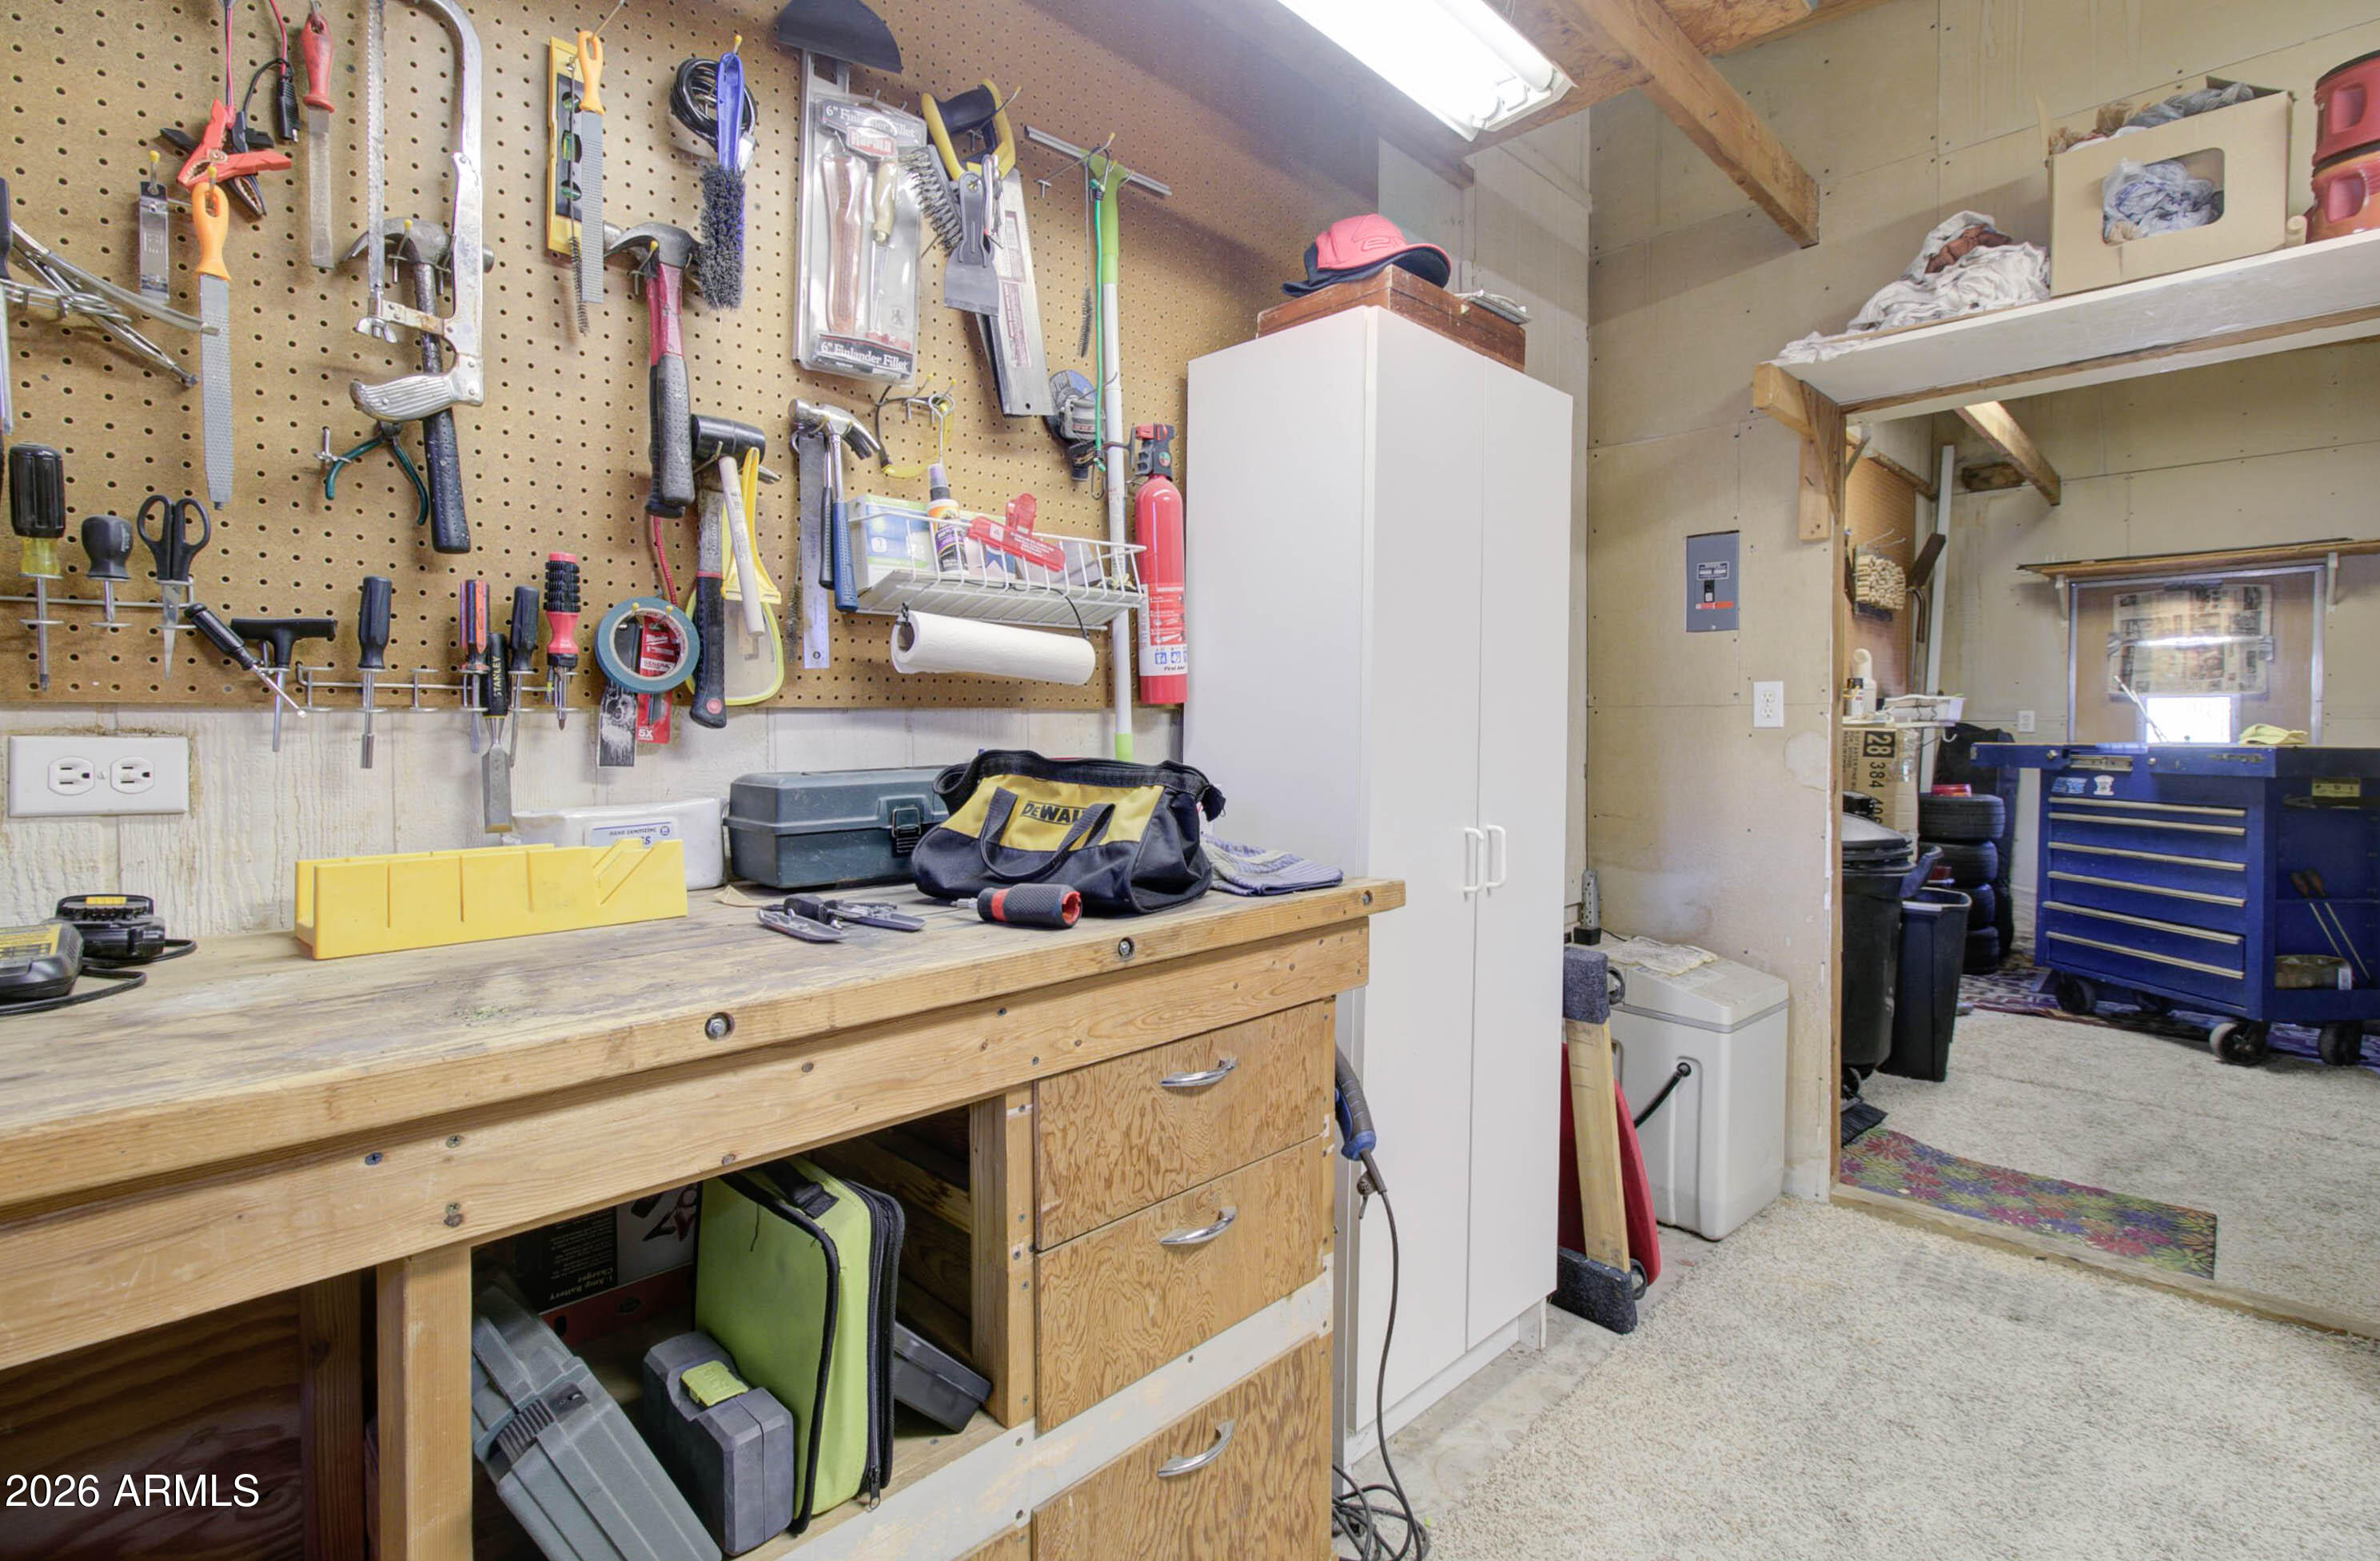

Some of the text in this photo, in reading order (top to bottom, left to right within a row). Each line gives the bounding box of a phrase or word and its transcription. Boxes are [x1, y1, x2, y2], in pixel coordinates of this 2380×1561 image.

[835, 344, 882, 364] Finlander
[883, 354, 909, 369] Fillet
[492, 655, 502, 698] STANLEY
[1867, 734, 1893, 756] 28
[1869, 761, 1886, 788] 384
